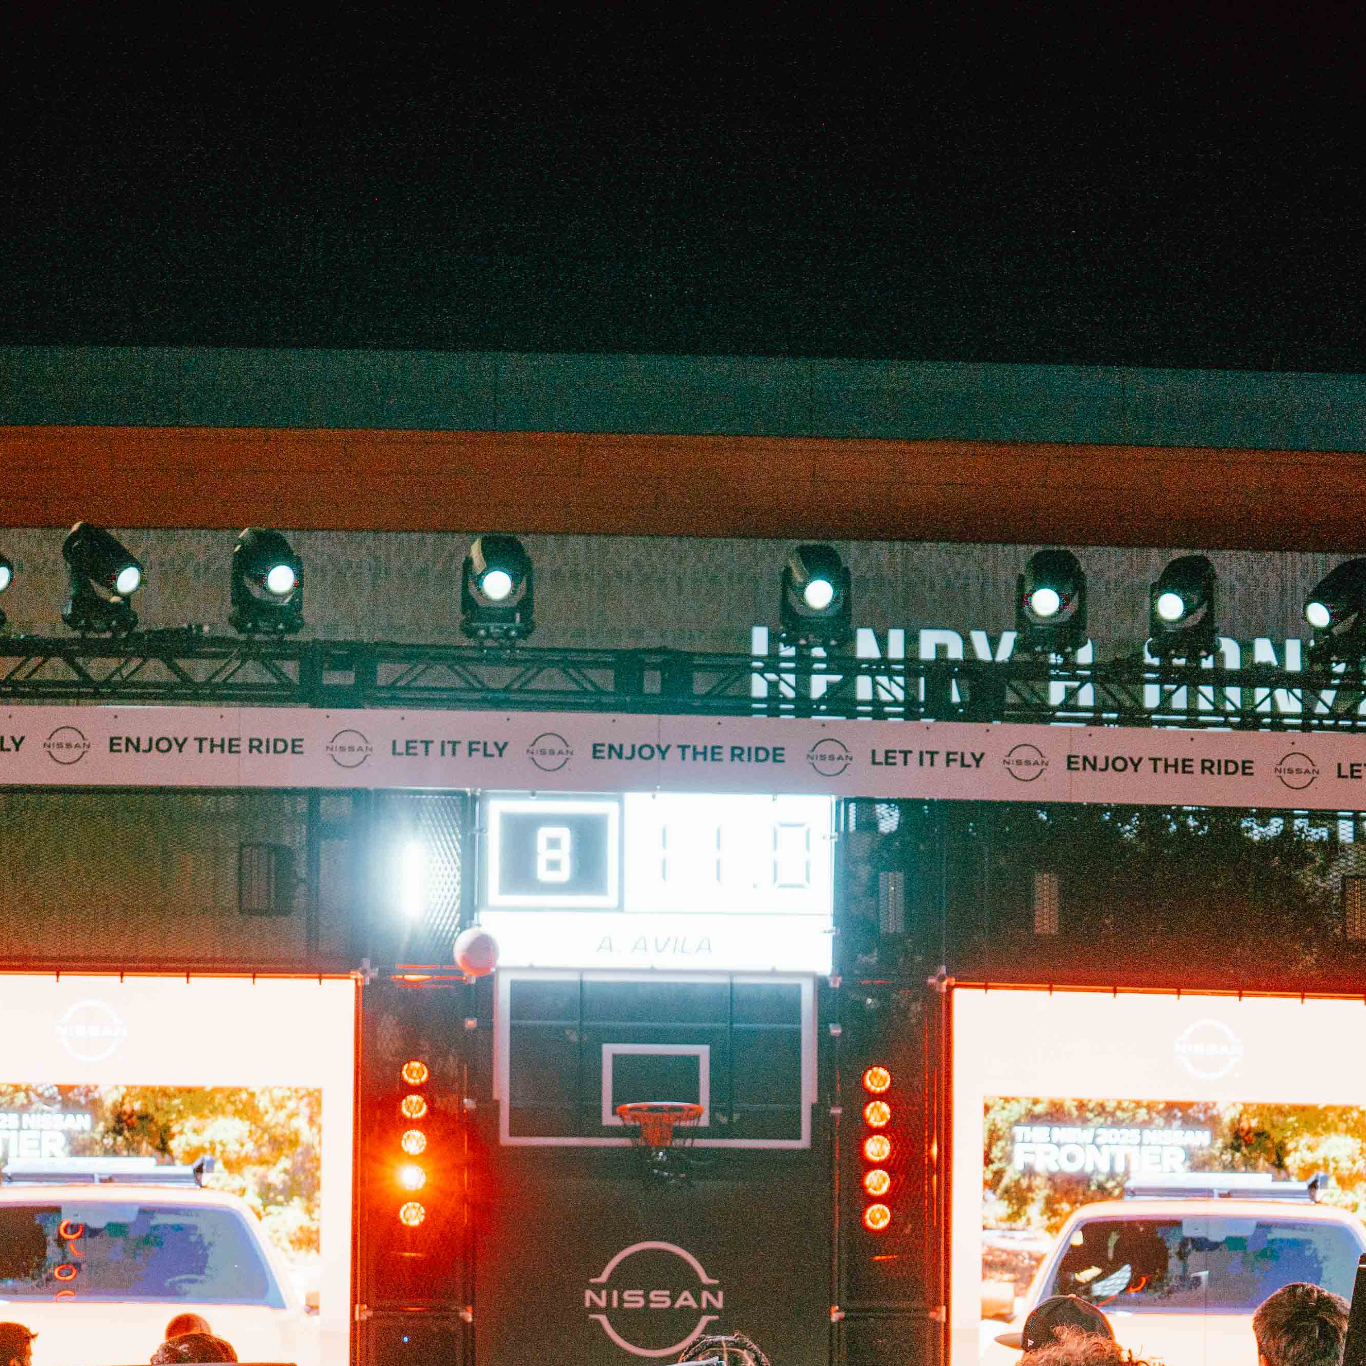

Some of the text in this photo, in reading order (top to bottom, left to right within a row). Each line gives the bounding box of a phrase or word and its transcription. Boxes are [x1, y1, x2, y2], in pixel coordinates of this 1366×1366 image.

[42, 741, 91, 750] NISSAN
[109, 736, 189, 754] ENJOY
[194, 737, 241, 754] THE
[248, 738, 304, 755] RIDE
[325, 744, 373, 752] NISSAN
[392, 739, 434, 756] LET
[440, 740, 461, 757] IT
[467, 741, 509, 758] FLY
[526, 748, 574, 756] NISSAN
[592, 743, 671, 761] ENJOY
[677, 744, 723, 762] THE
[730, 745, 786, 763] RIDE
[806, 753, 853, 762] NISSAN
[870, 749, 913, 766] LET
[919, 750, 939, 767] IT
[945, 751, 985, 768] FLY
[1002, 758, 1049, 767] NISSAN
[1066, 754, 1140, 774] ENJOY
[1148, 756, 1194, 775] THE
[1201, 758, 1254, 776] RIDE
[1274, 766, 1320, 776] NISSAN
[537, 826, 571, 883] 8
[632, 935, 714, 955] AVILA
[22, 1114, 91, 1131] NISSAN
[1013, 1126, 1050, 1143] THE
[1051, 1127, 1094, 1144] NEW
[1014, 1143, 1185, 1172] FRONTIER
[584, 1289, 724, 1309] NISSAN
